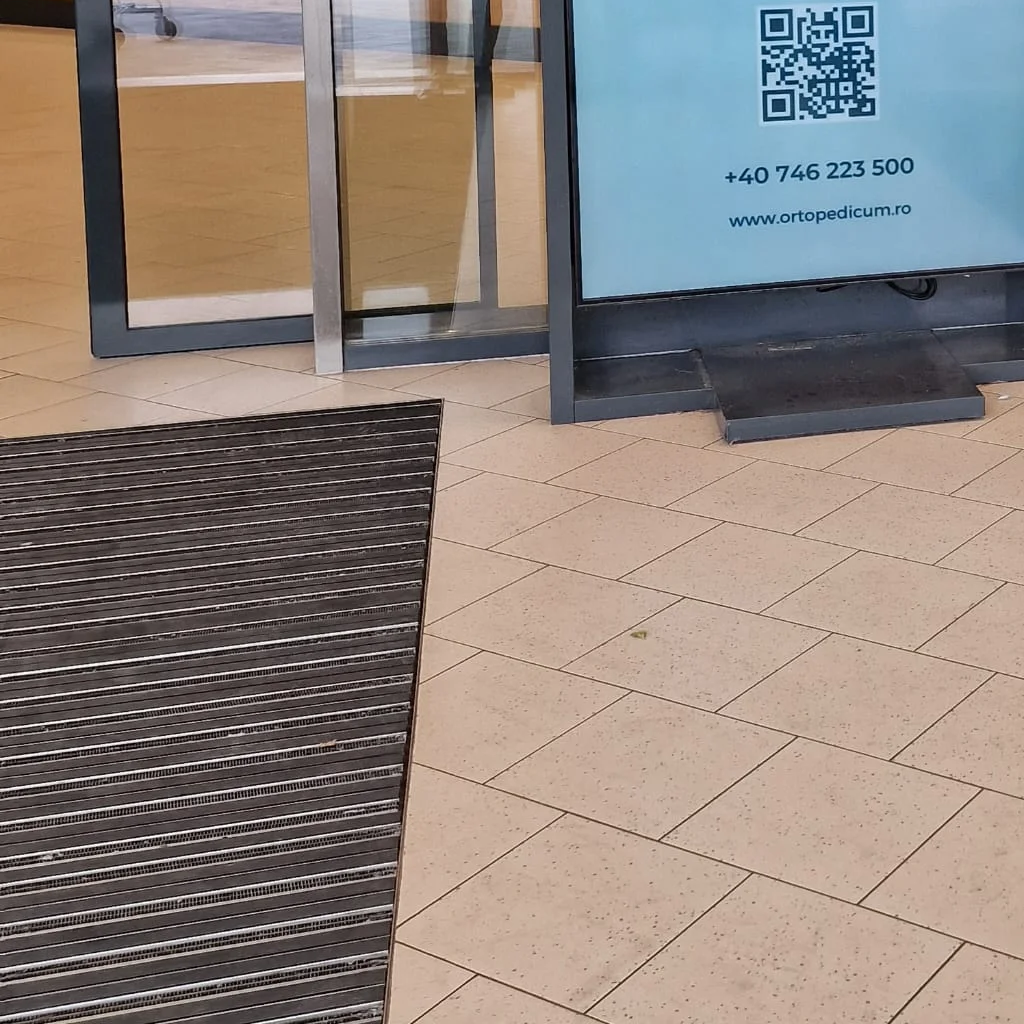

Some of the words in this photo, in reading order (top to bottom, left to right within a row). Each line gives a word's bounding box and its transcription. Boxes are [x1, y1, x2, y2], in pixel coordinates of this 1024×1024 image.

[724, 166, 769, 185] +40
[775, 163, 820, 183] 746
[826, 160, 866, 180] 223
[871, 157, 914, 177] 500
[728, 204, 912, 229] www.ortopedicum.ro
